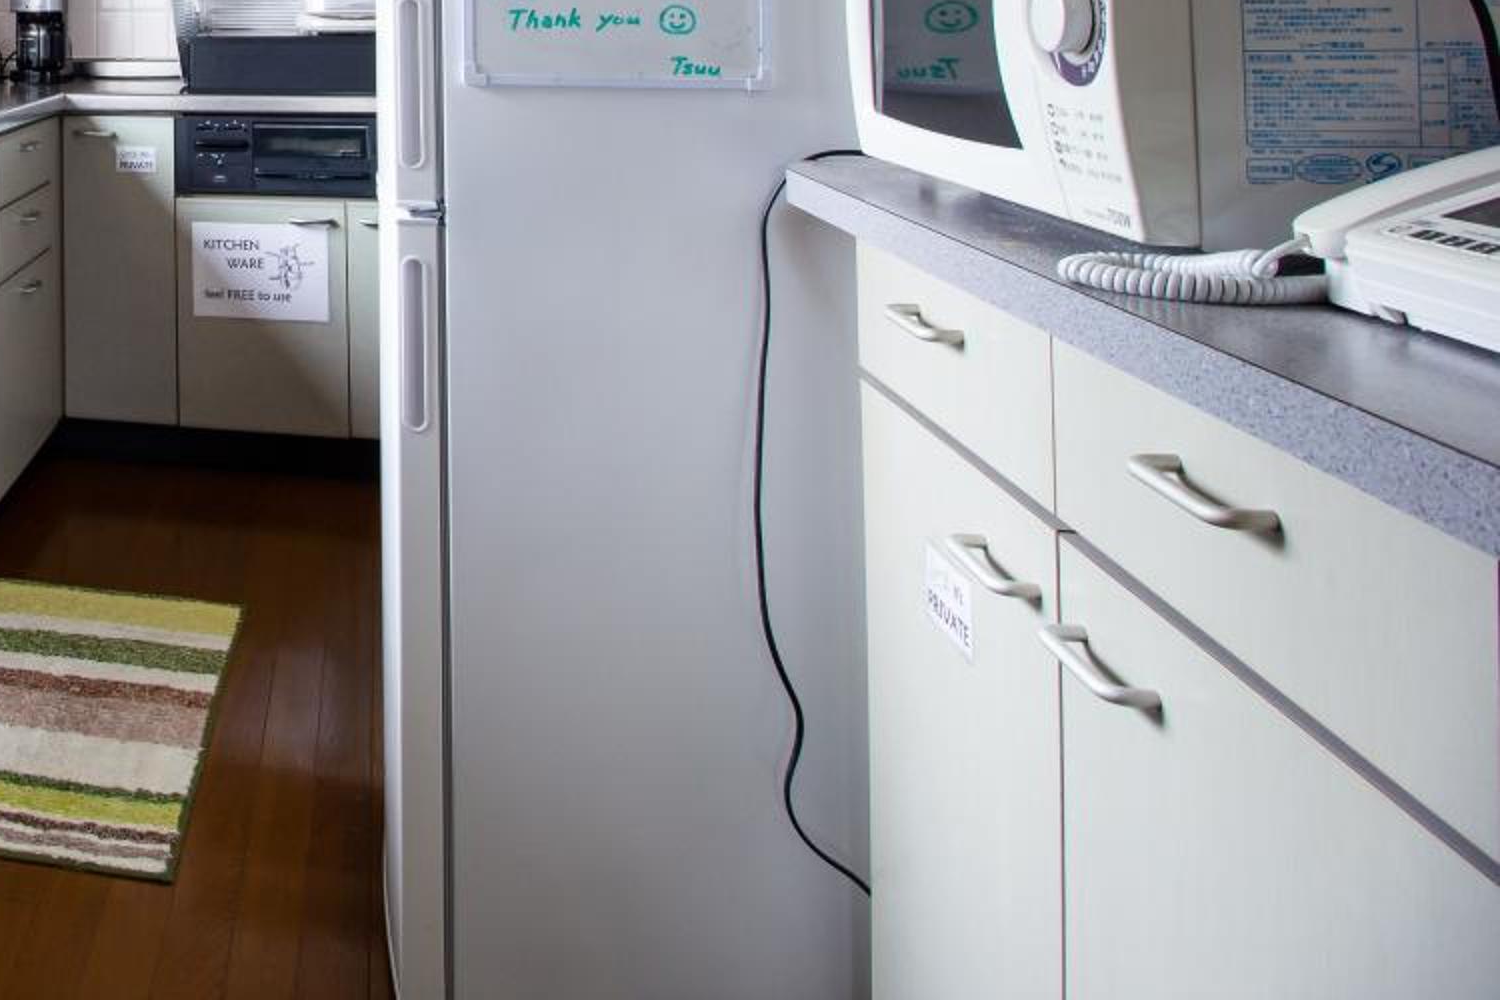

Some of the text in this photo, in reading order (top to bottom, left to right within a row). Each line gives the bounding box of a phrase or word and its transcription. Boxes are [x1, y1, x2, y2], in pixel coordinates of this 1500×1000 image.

[509, 7, 642, 32] Thank you
[203, 239, 260, 250] KITCHEN
[227, 258, 265, 269] WARE
[227, 289, 255, 301] FREE
[257, 290, 271, 301] to
[273, 292, 292, 302] use
[927, 587, 970, 648] PRIVATE
